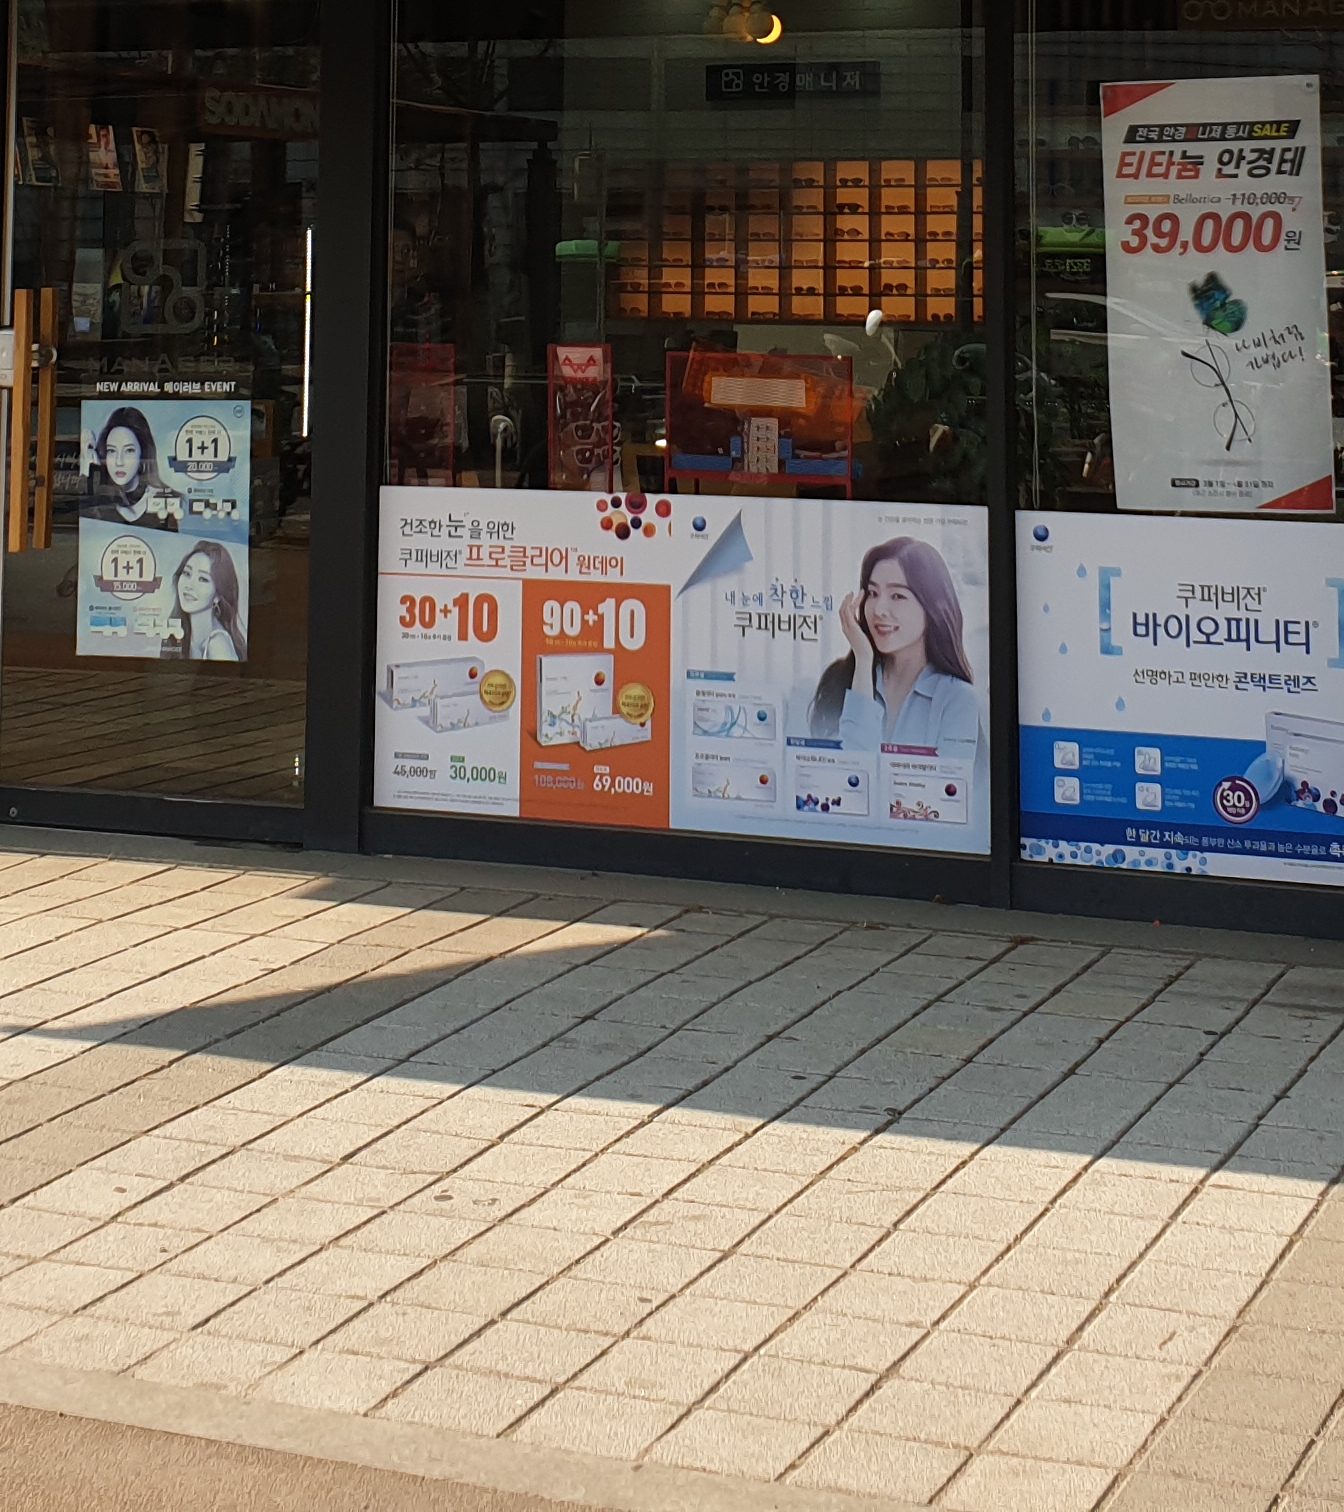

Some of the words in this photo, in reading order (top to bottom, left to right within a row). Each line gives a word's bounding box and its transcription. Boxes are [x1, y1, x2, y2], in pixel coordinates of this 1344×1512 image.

[1136, 127, 1159, 140] 전국
[1252, 123, 1290, 136] SALE
[1215, 145, 1306, 179] 안경테
[96, 382, 119, 392] NEW
[120, 382, 161, 392] ARRIVAL
[204, 382, 236, 392] EVENT
[185, 436, 219, 459] 1+1
[399, 518, 443, 537] 건조한
[486, 520, 516, 541] 위한
[110, 556, 144, 578] 1+1
[398, 547, 459, 570] 쿠퍼비전
[464, 544, 570, 574] 프로클리어
[576, 554, 625, 576] 원데이
[769, 581, 807, 608] 착한
[1175, 582, 1263, 613] 쿠퍼비전
[733, 611, 819, 642] 쿠퍼비전
[1131, 611, 1312, 655] 바이오피니티
[1132, 667, 1186, 685] 선명하고
[1188, 671, 1230, 688] 편안한
[1232, 671, 1319, 693] 콘택트렌즈
